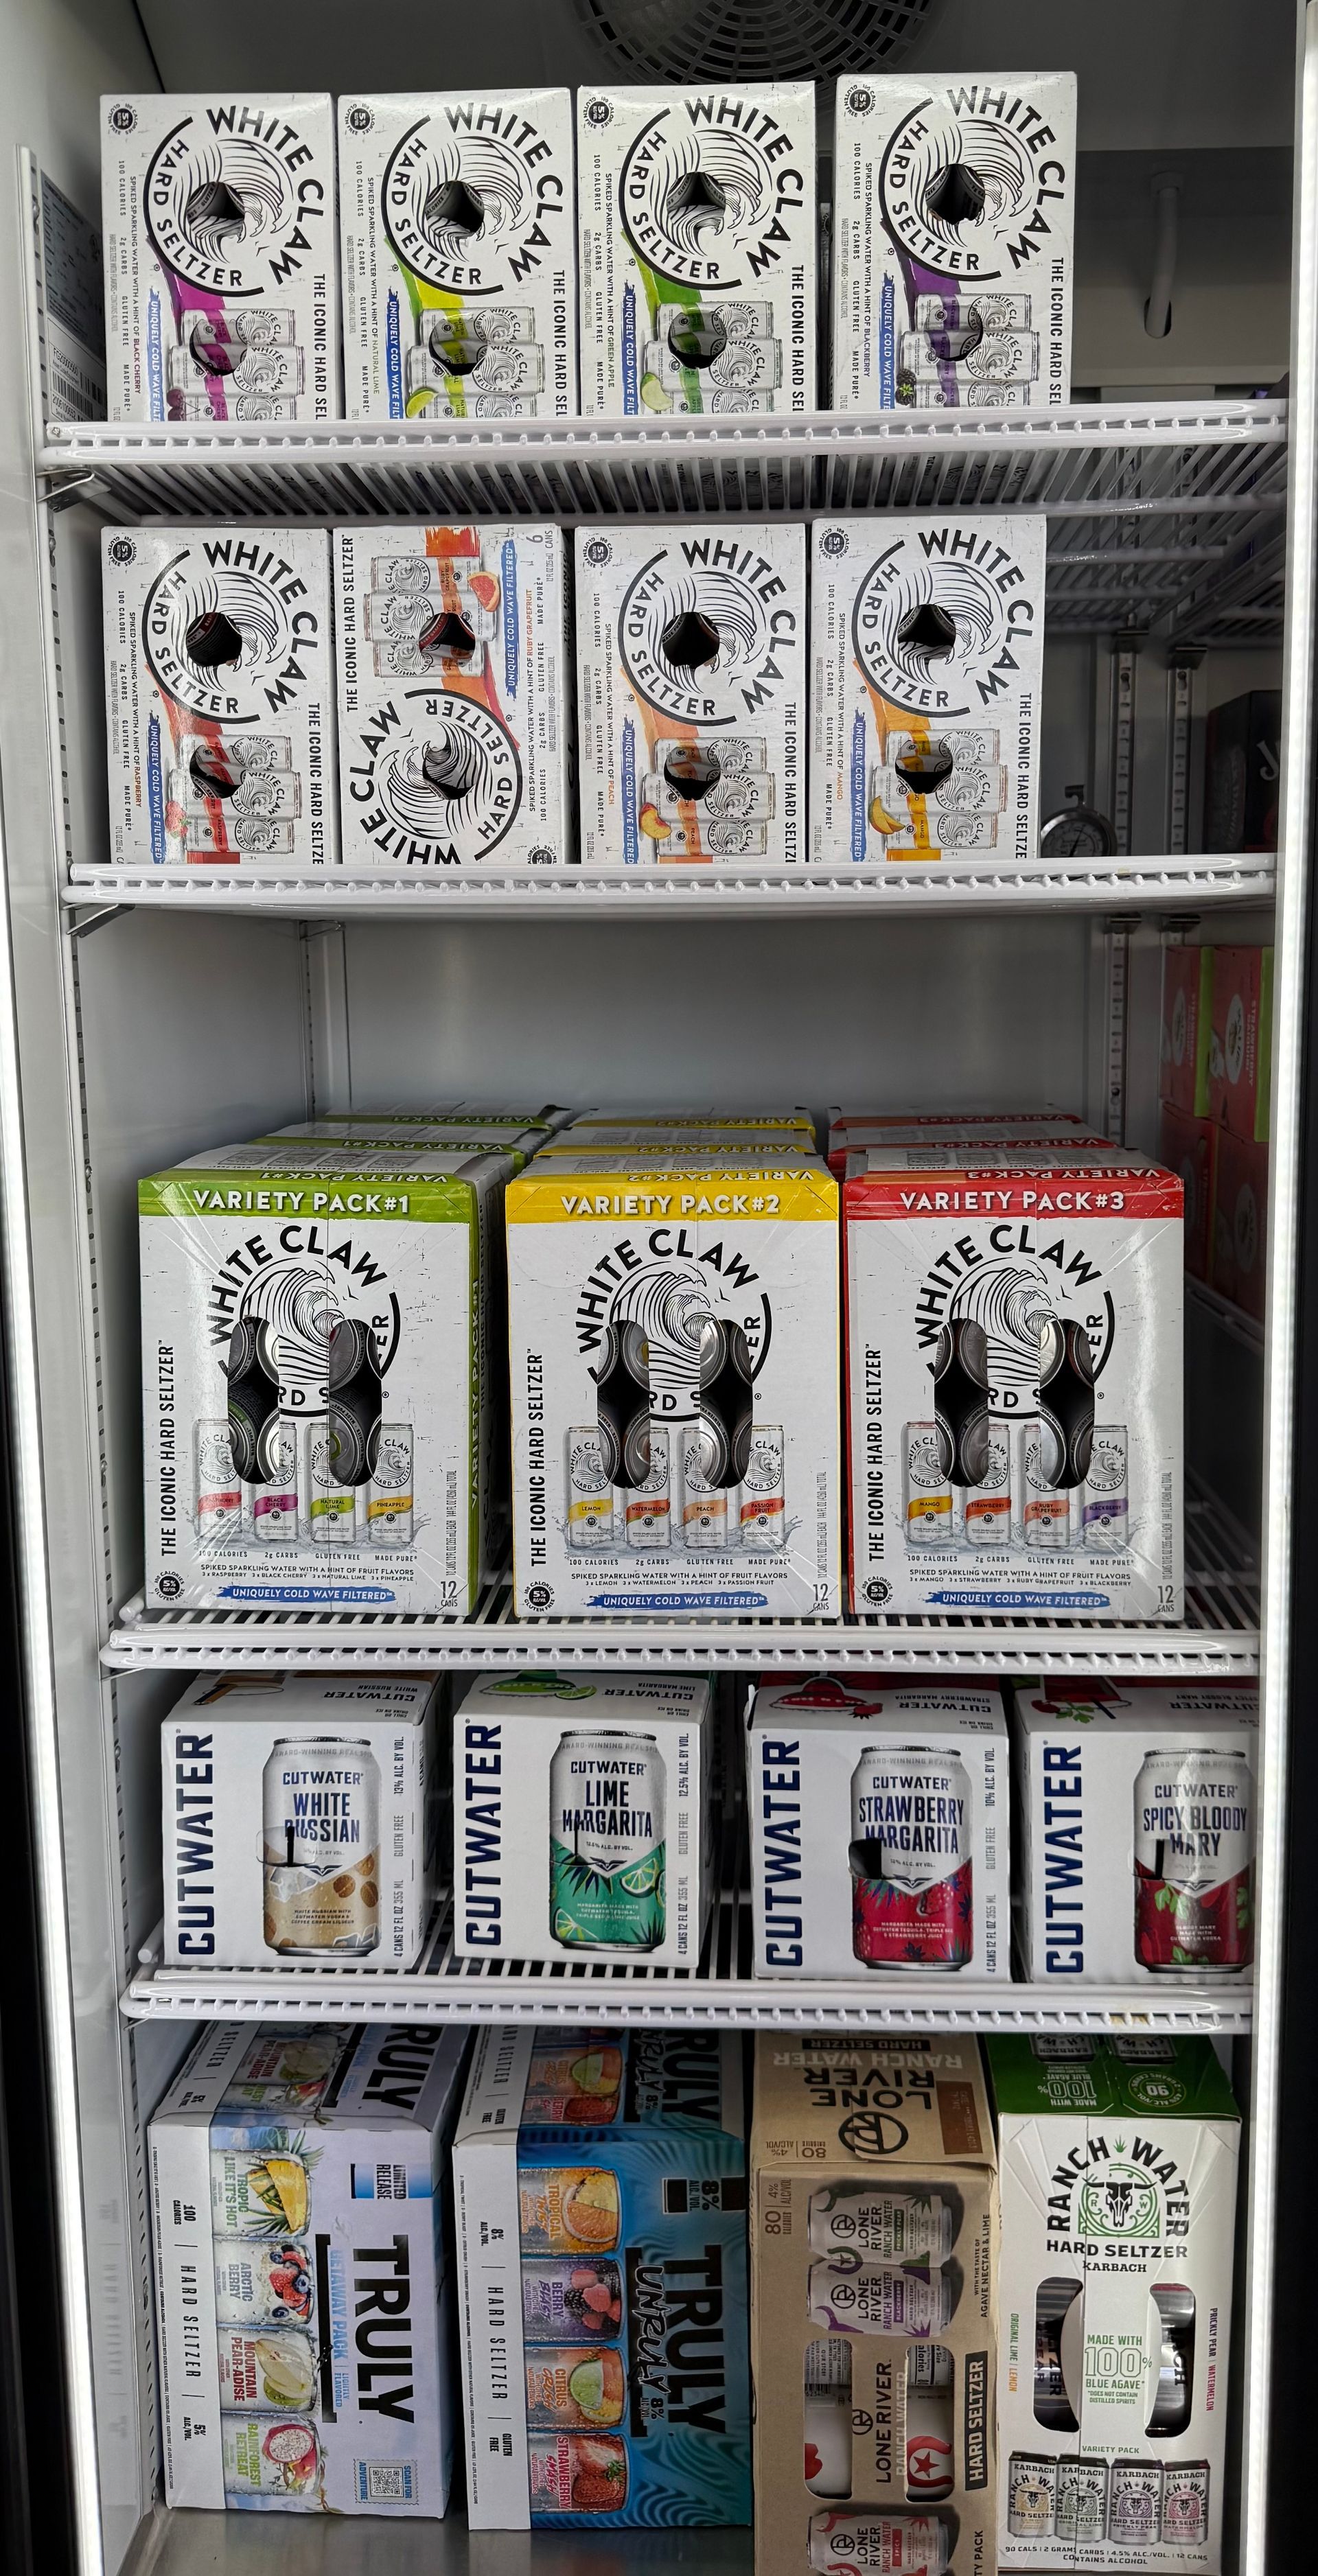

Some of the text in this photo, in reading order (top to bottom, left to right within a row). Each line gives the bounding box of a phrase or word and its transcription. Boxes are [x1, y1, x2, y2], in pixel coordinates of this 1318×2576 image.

[206, 104, 325, 286] WHITE CLAW
[445, 102, 564, 282] WHITE CLAW
[684, 95, 803, 278] WHITE CLAW
[889, 119, 979, 270] HARD SELTZER
[947, 85, 1065, 270] WHITE CLAW
[154, 139, 243, 288] HARD SELTZER
[392, 138, 481, 286] HARD SELTZER
[133, 326, 139, 336] OF
[545, 531, 553, 548] CANS
[203, 539, 318, 712] WHITE CLAW
[344, 597, 356, 631] HARD
[680, 539, 796, 715] WHITE CLAW
[918, 529, 1033, 706] WHITE CLAW
[345, 637, 358, 684] ICONIC
[507, 644, 516, 686] UNIQUELY
[347, 689, 358, 712] THE
[350, 701, 461, 863] WHITE CLAW
[426, 698, 511, 839] HARD SELTZER
[193, 1190, 304, 1211] VARIETY
[562, 1194, 672, 1215] VARIETY
[900, 1192, 1012, 1211] VARIETY
[207, 1225, 387, 1347] WHITE CLAW
[575, 1229, 759, 1354] WHITE CLAW
[914, 1225, 1102, 1349] WHITE CLAW
[440, 1581, 456, 1599] 12
[441, 1599, 458, 1608] CANS
[571, 1761, 644, 1775] CUTWATER
[678, 1749, 689, 1758] BY
[678, 1761, 689, 1774] ALC.
[283, 1771, 361, 1785] CUTWATER
[586, 1780, 629, 1807] LIME
[872, 1776, 949, 1790] CUTWATER
[293, 1792, 350, 1817] WHITE
[562, 1809, 652, 1837] MARGARITA
[859, 1796, 963, 1826] STRAWBERRY
[1144, 1807, 1247, 1831] SPICY BLOODY
[176, 1734, 215, 1955] CUTWATER
[284, 1819, 360, 1843] RUSSIAN
[465, 1724, 501, 1945] CUTWATER
[678, 1813, 688, 1854] GLUTEN FREE
[865, 1825, 958, 1854] MARGARITA
[1170, 1833, 1221, 1856] MARY
[762, 1741, 802, 1966] CUTWATER
[1043, 1745, 1083, 1973] CUTWATER
[773, 2052, 964, 2069] RANCH WATER
[803, 2067, 936, 2088] RIVER
[810, 2089, 934, 2110] LONE
[224, 2157, 238, 2228] LIKE IT'S HOT
[238, 2173, 249, 2213] TROPIC
[1047, 2135, 1190, 2237] RANCH WATER
[548, 2184, 559, 2240] TROPICAL
[1046, 2239, 1188, 2258] HARD SELTZER
[1083, 2260, 1147, 2273] KARBACH
[229, 2263, 242, 2301] BERRY
[240, 2262, 253, 2302] ARCTIC
[552, 2282, 564, 2318] BERRY
[181, 2265, 200, 2378] HARD SELTZER
[353, 2235, 415, 2424] TRULY
[664, 2244, 726, 2433] TRULY
[1087, 2334, 1142, 2346] MADE WITH
[231, 2336, 245, 2402] PEAR-ADISE
[244, 2341, 257, 2398] MOUNTAIN
[1009, 2313, 1019, 2391] ORIGINAL LIME LEMON
[1084, 2347, 1153, 2378] 100%
[1206, 2308, 1218, 2411] PRICKLY PEAR WATERMELON
[554, 2368, 567, 2407] CITRUS
[1085, 2379, 1109, 2389] BLUE
[876, 2361, 892, 2483] LONE RIVER
[969, 2360, 984, 2481] HARD SELTZER
[236, 2432, 248, 2476] RETREAT
[247, 2423, 262, 2487] RAINFOREST
[1082, 2445, 1140, 2455] VARIETY PACK
[359, 2461, 368, 2500] ADVENTURE
[404, 2465, 412, 2484] SCAN
[556, 2436, 573, 2509] STRAWBERRY
[1063, 2554, 1105, 2564] CONTAINS
